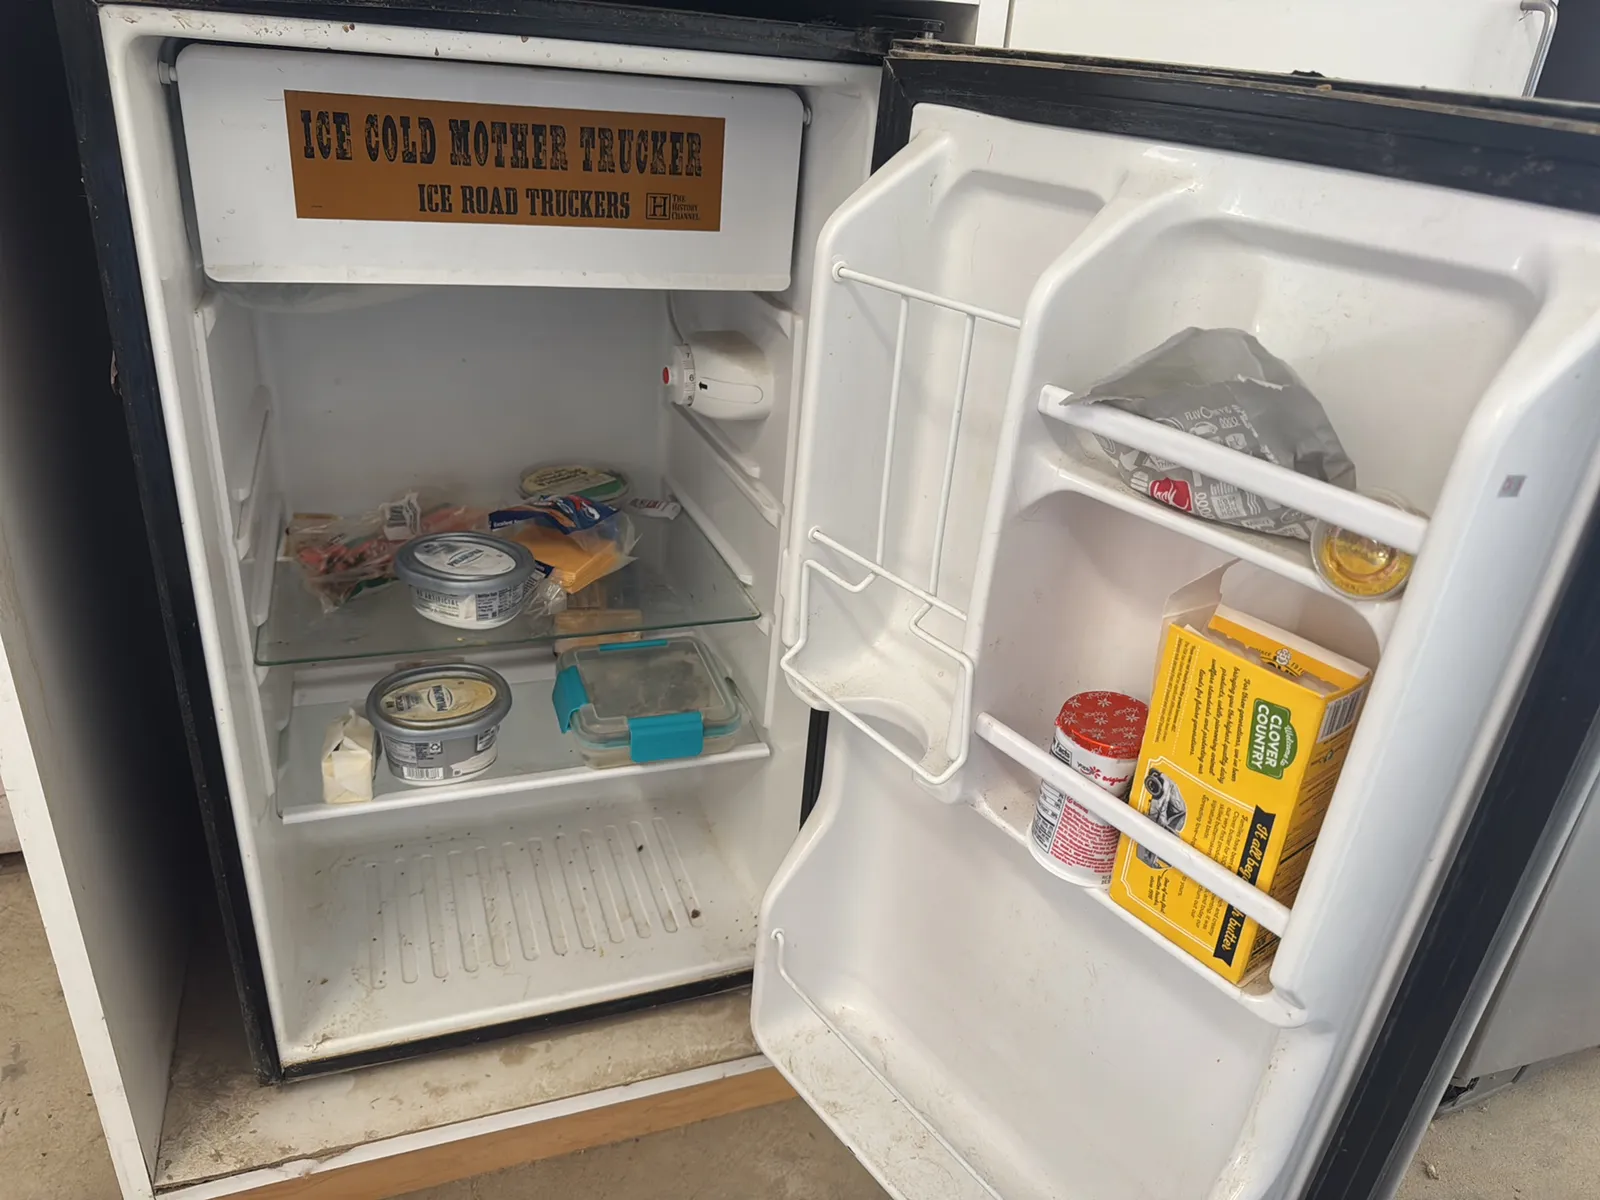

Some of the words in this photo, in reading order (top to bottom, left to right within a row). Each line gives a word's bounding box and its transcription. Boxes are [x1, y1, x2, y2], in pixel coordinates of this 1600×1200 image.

[301, 110, 352, 160] ICE
[365, 114, 436, 164] COLD
[449, 119, 568, 171] MOTHER
[580, 127, 701, 177] TRUCKER
[418, 184, 452, 213] ICE
[461, 186, 518, 215] ROAD
[526, 188, 630, 219] TRUCKERS
[649, 196, 668, 217] H
[672, 194, 686, 203] THE
[672, 211, 700, 221] CHANNEL
[1250, 704, 1269, 769] COUNTRY
[1264, 713, 1281, 767] CLOVER
[1282, 724, 1293, 759] Welcome
[1279, 758, 1288, 766] to
[1253, 822, 1269, 842] It
[1213, 840, 1221, 862] produc
[1247, 837, 1262, 861] all
[1239, 855, 1259, 885] beg
[1220, 916, 1241, 953] butter
